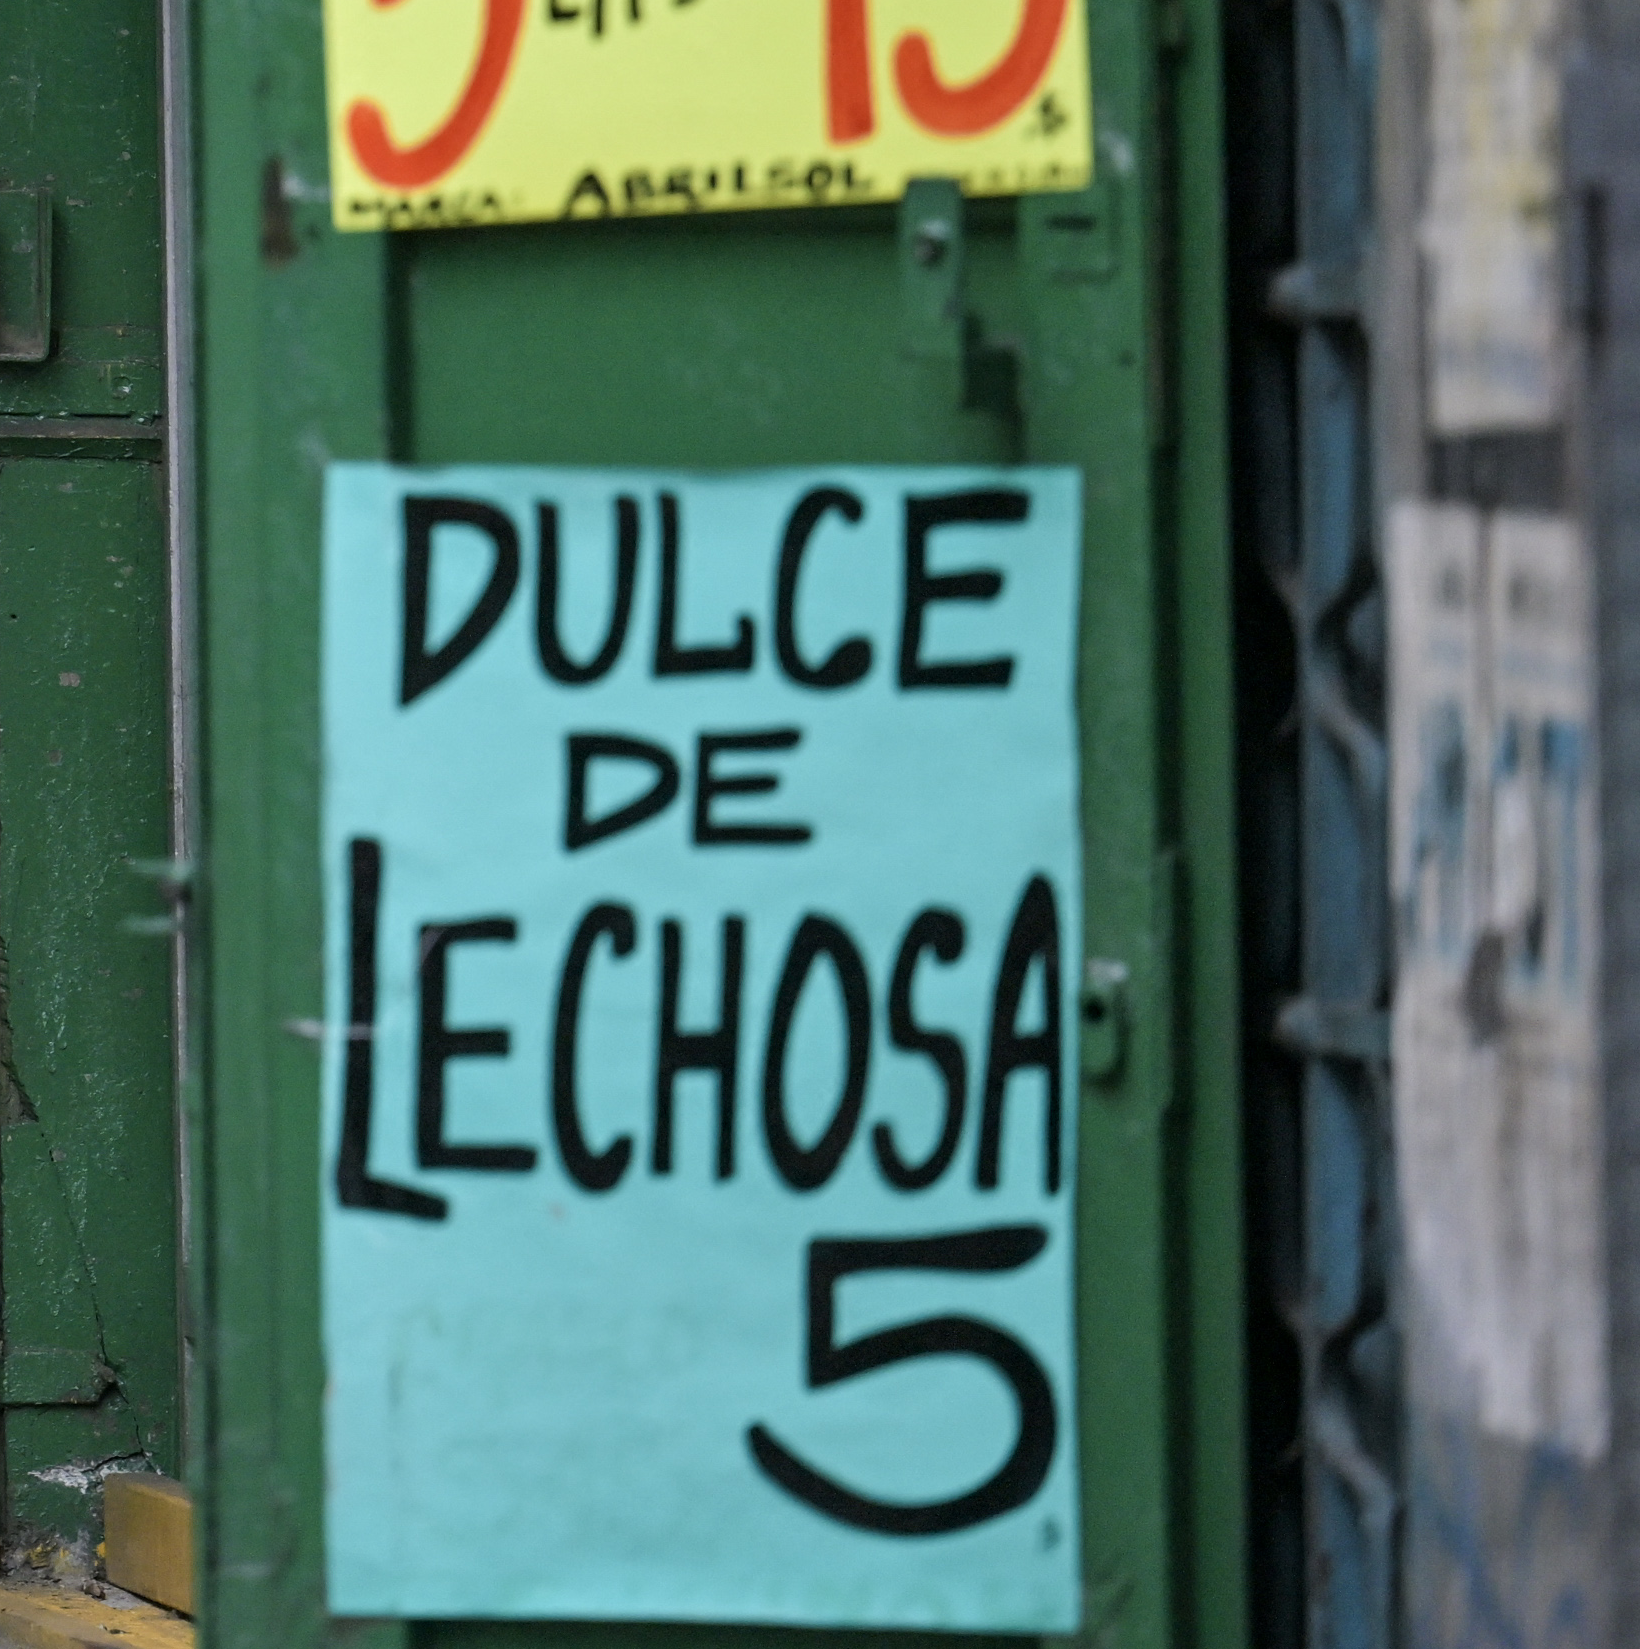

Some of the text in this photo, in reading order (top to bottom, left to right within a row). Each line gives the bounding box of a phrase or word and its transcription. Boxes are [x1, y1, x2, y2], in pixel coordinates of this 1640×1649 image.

[397, 486, 1032, 710] DULCE
[565, 729, 815, 853] DE
[335, 836, 1062, 1223] LECHOSA
[745, 1222, 1058, 1537] 5
